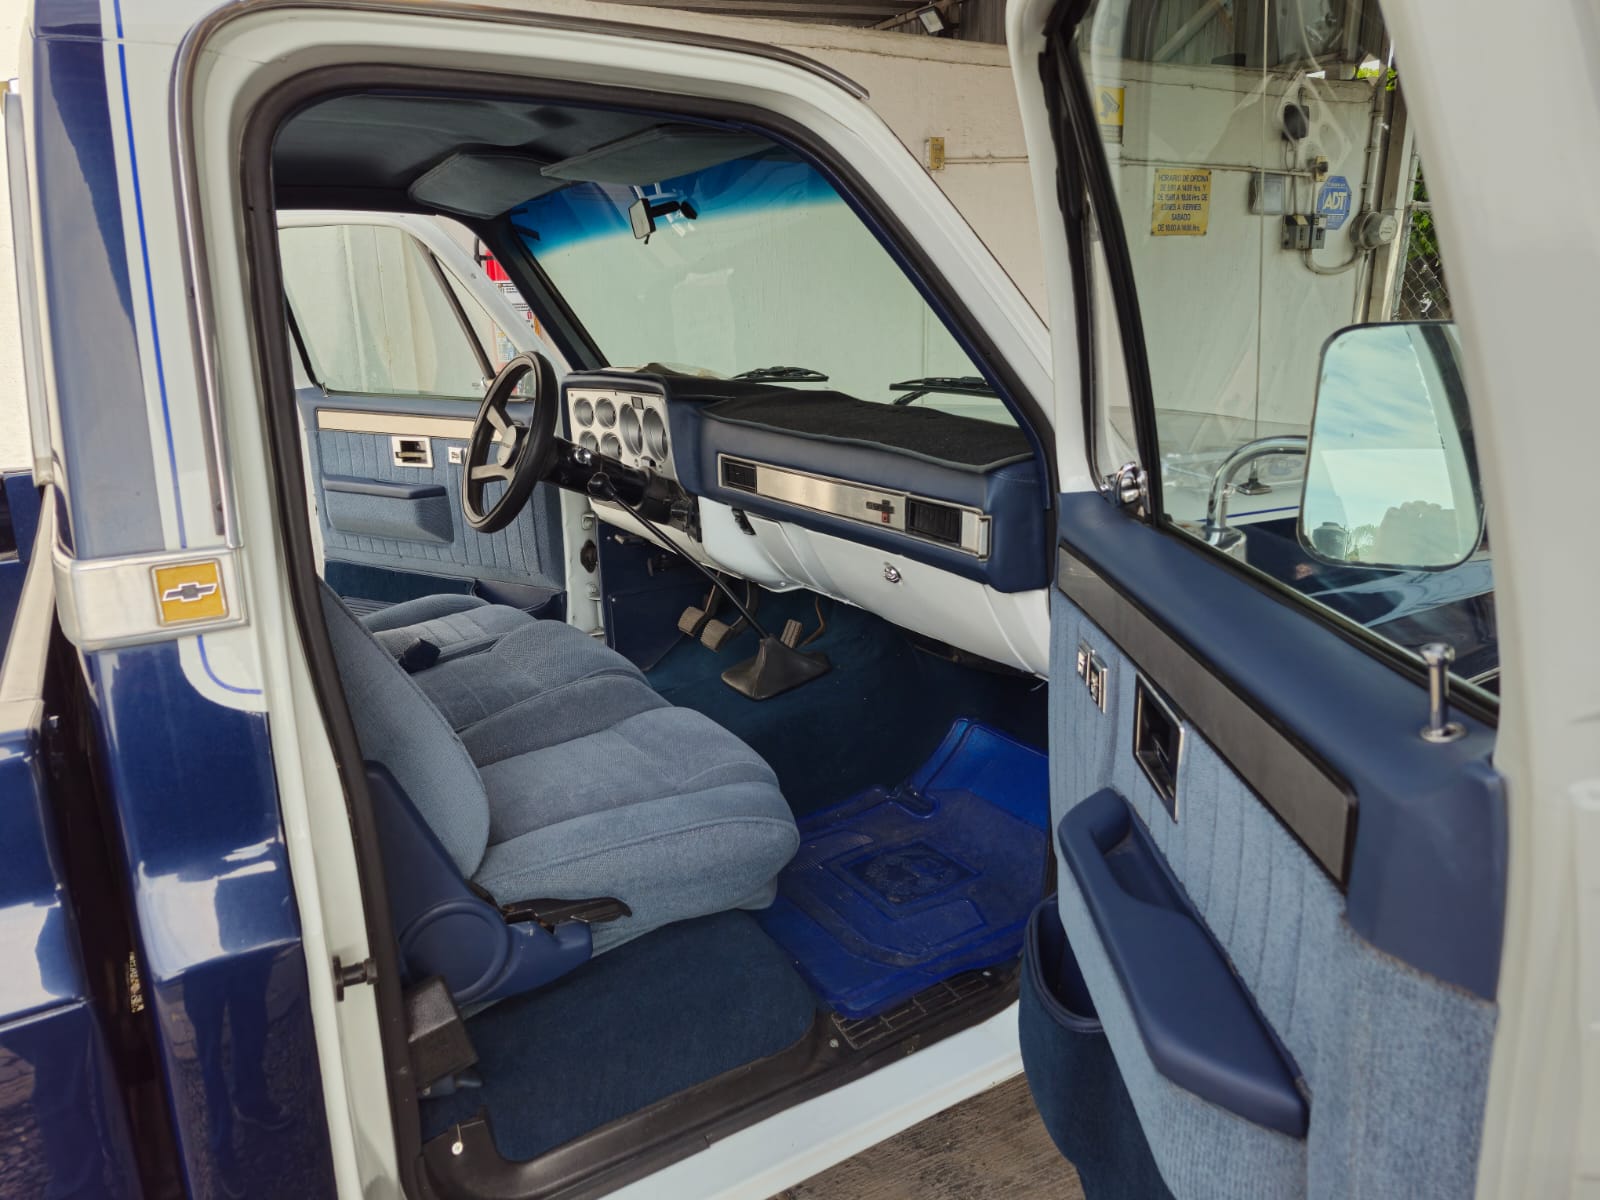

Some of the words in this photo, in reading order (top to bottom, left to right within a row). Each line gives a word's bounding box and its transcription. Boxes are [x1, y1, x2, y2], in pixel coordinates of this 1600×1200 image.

[1182, 174, 1189, 182] DE
[1190, 174, 1208, 182] OFICINA
[1201, 193, 1208, 201] DE
[1323, 191, 1347, 210] ADT
